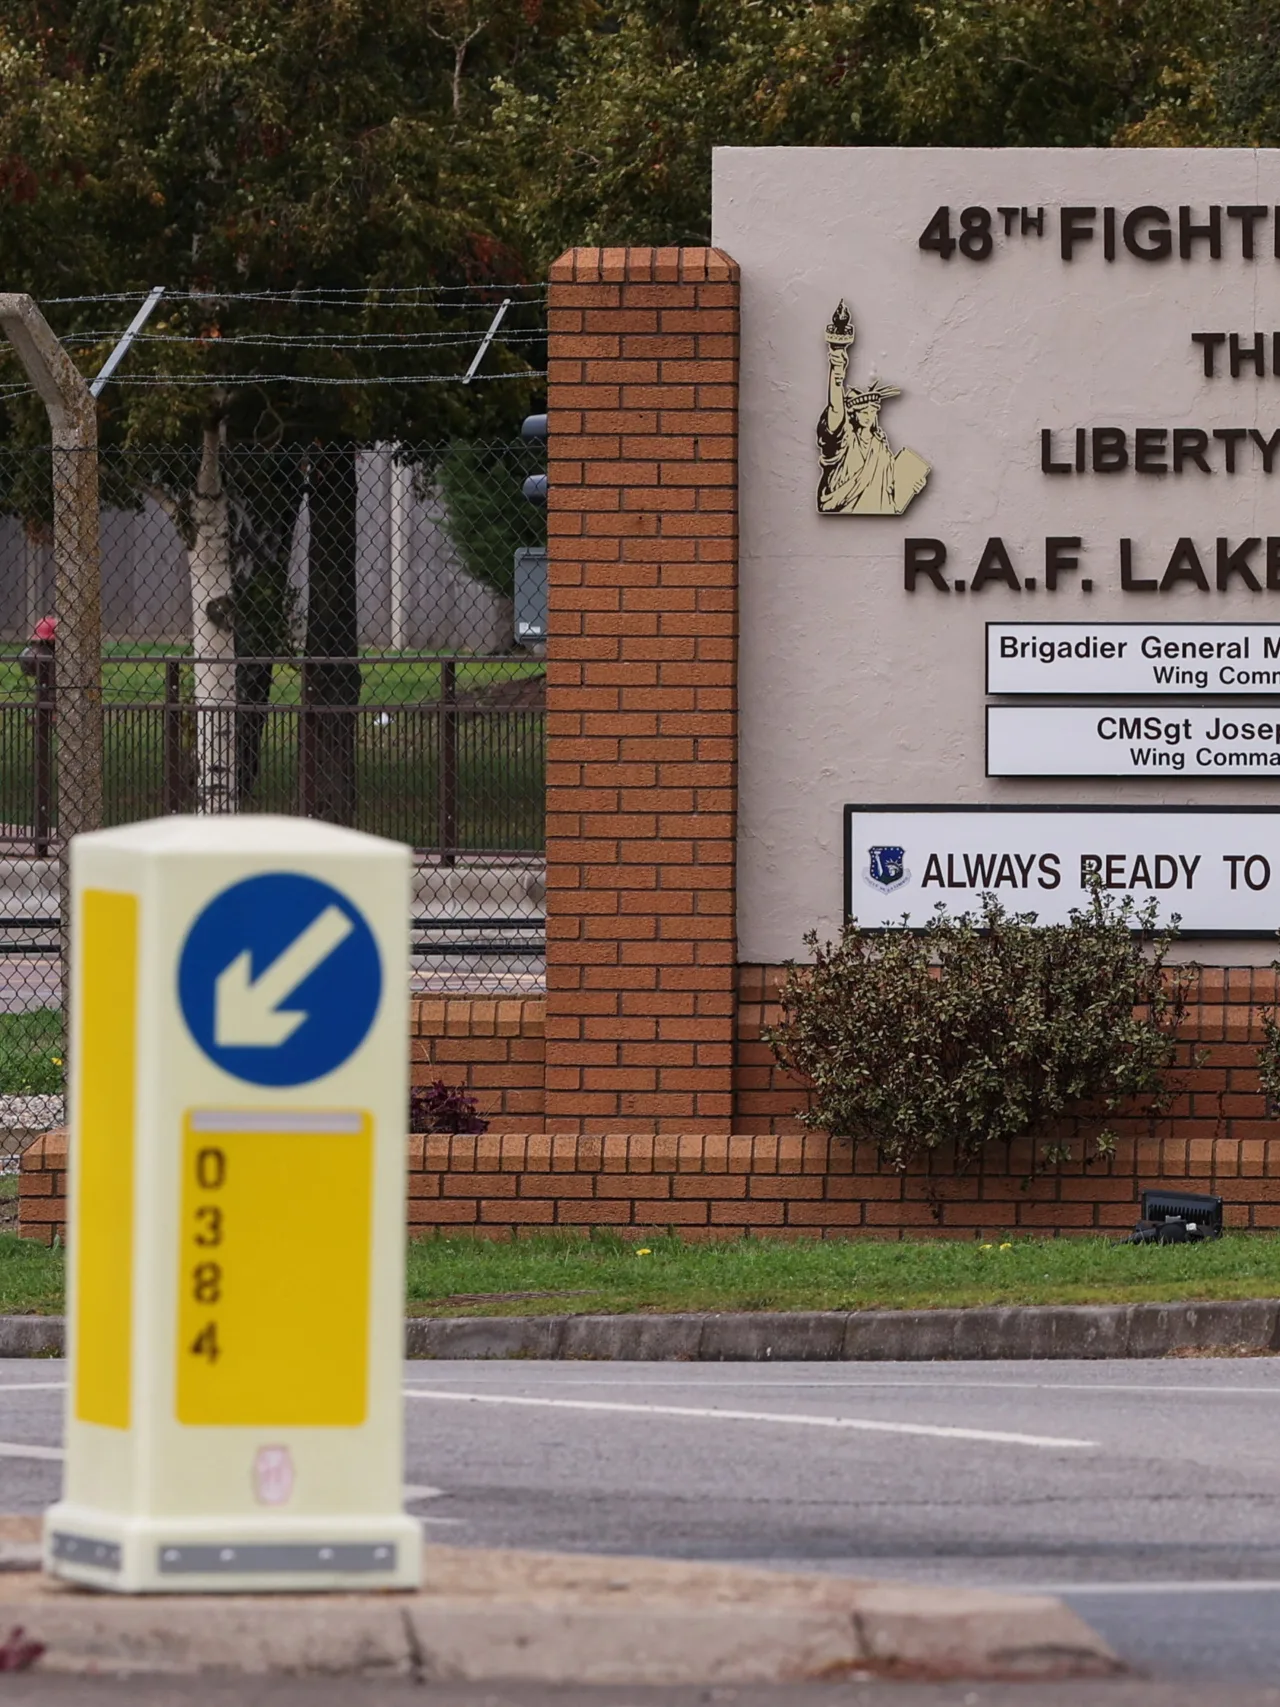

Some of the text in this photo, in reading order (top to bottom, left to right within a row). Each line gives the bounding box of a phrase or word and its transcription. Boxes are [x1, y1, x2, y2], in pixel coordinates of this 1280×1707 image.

[918, 205, 1045, 263] 48TH
[904, 536, 1093, 595] R.A.F.
[999, 635, 1128, 662] Brigadier
[1140, 635, 1250, 660] General
[1152, 665, 1208, 689] Wing
[1097, 716, 1193, 744] CMSgt
[1129, 747, 1185, 771] Wing
[921, 852, 1062, 889] ALWAYS
[1080, 853, 1202, 890] READY
[1223, 854, 1271, 891] TO
[188, 1146, 227, 1366] 0384
